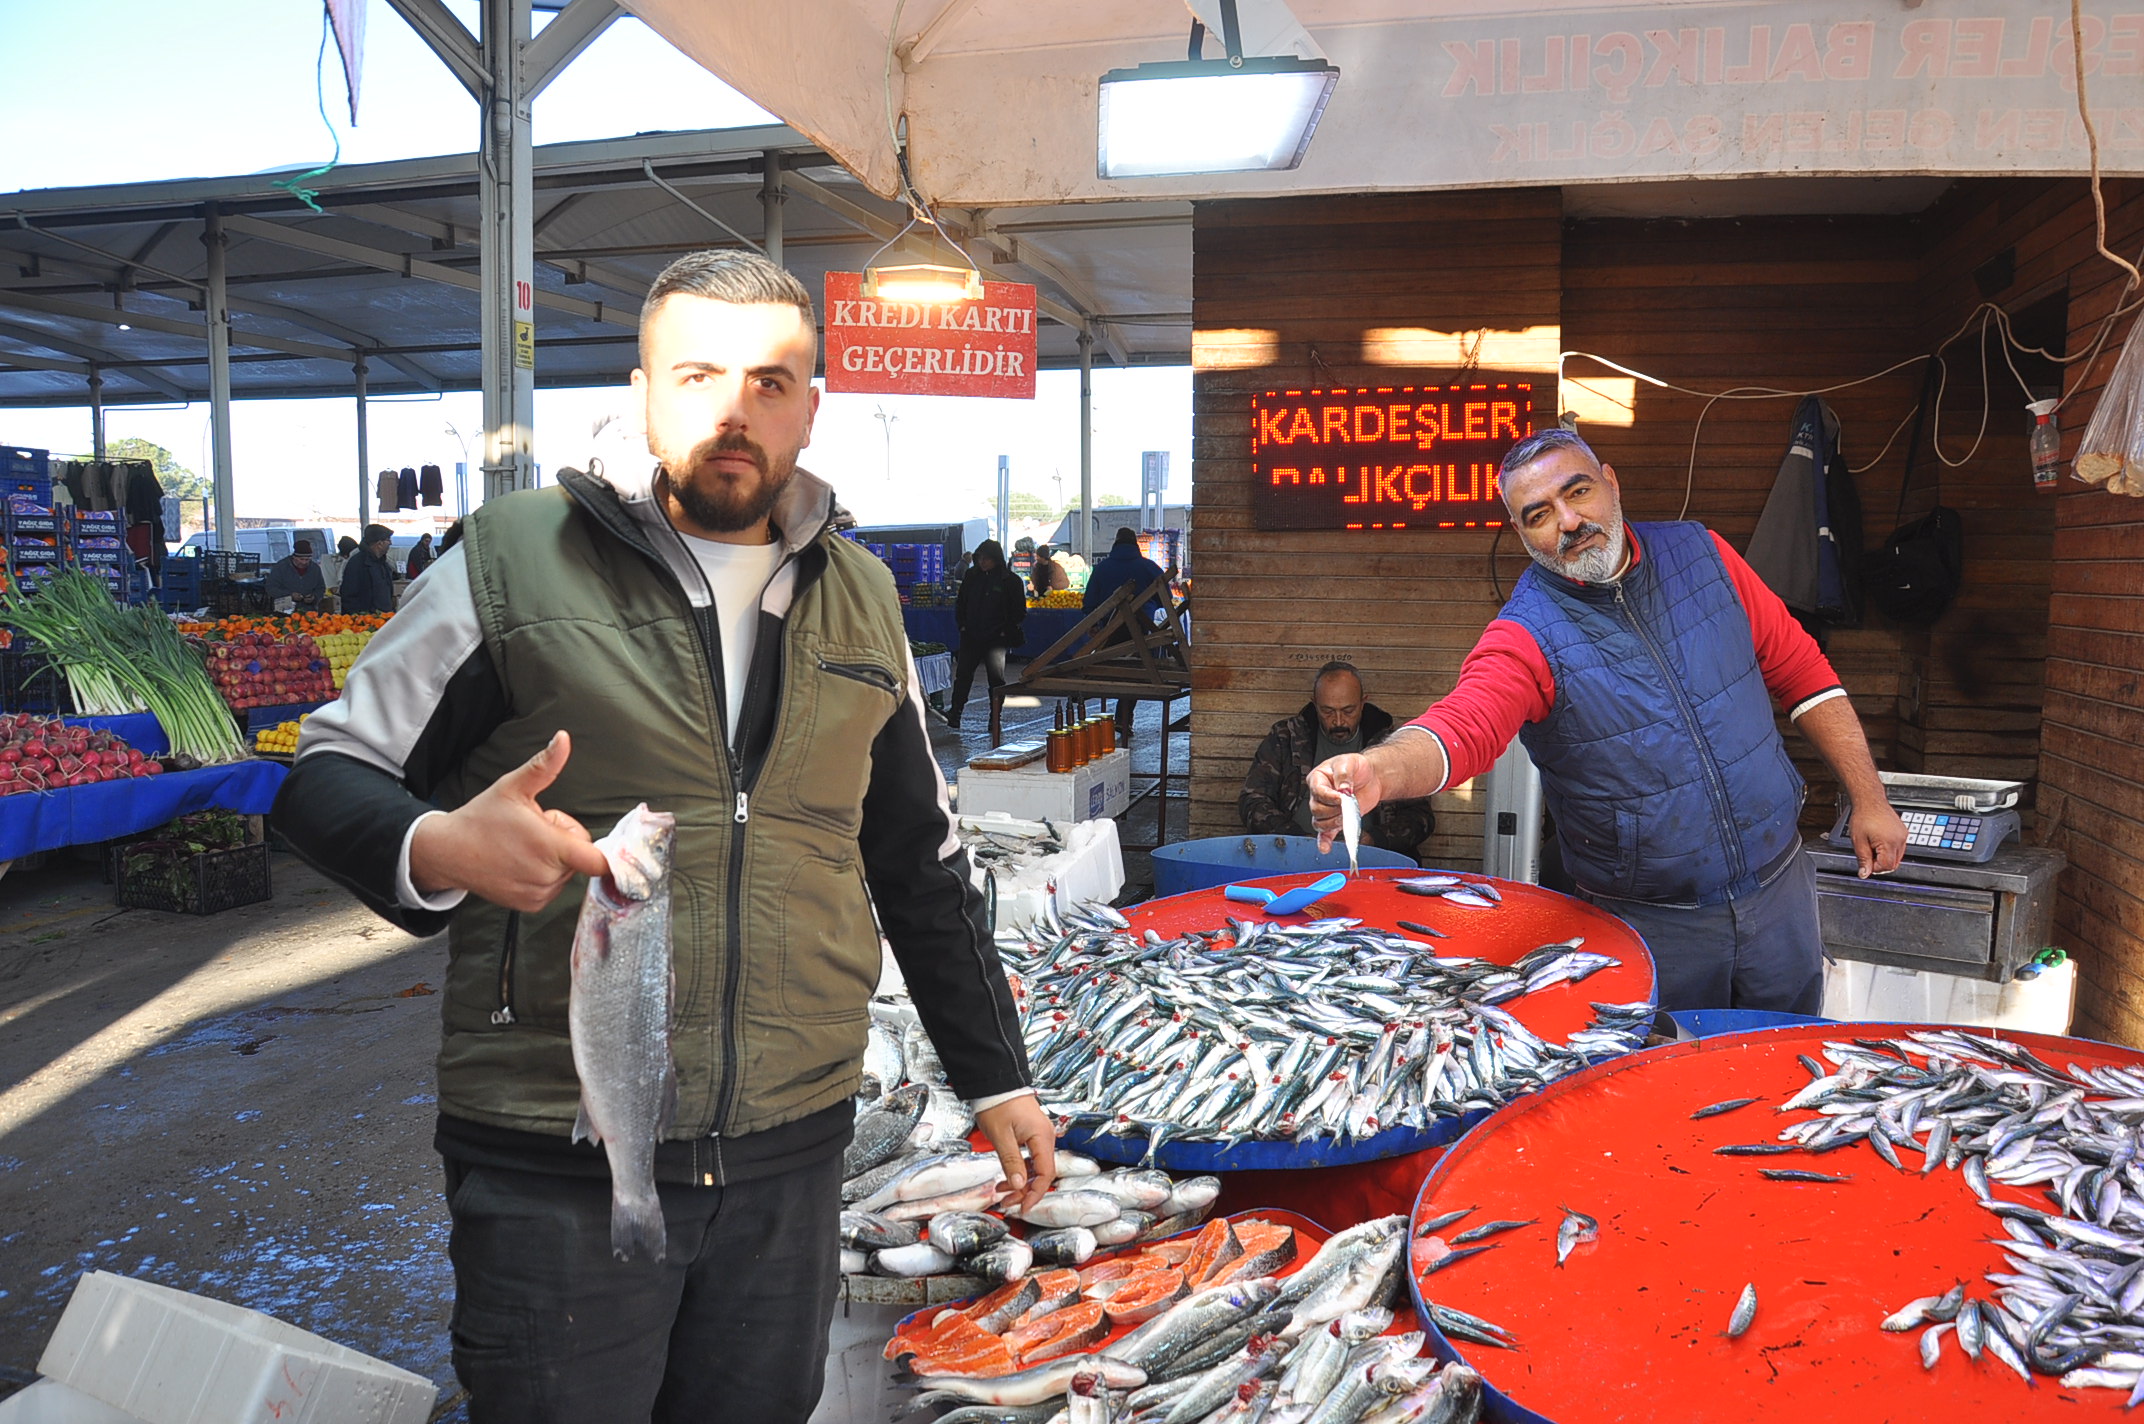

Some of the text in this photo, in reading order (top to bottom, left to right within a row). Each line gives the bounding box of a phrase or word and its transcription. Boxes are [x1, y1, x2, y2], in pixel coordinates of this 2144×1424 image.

[517, 281, 531, 310] 10
[937, 304, 1033, 334] KARTI
[842, 343, 1025, 378] GEÇERLİDİR
[1260, 402, 1520, 449] KARDEŞLER
